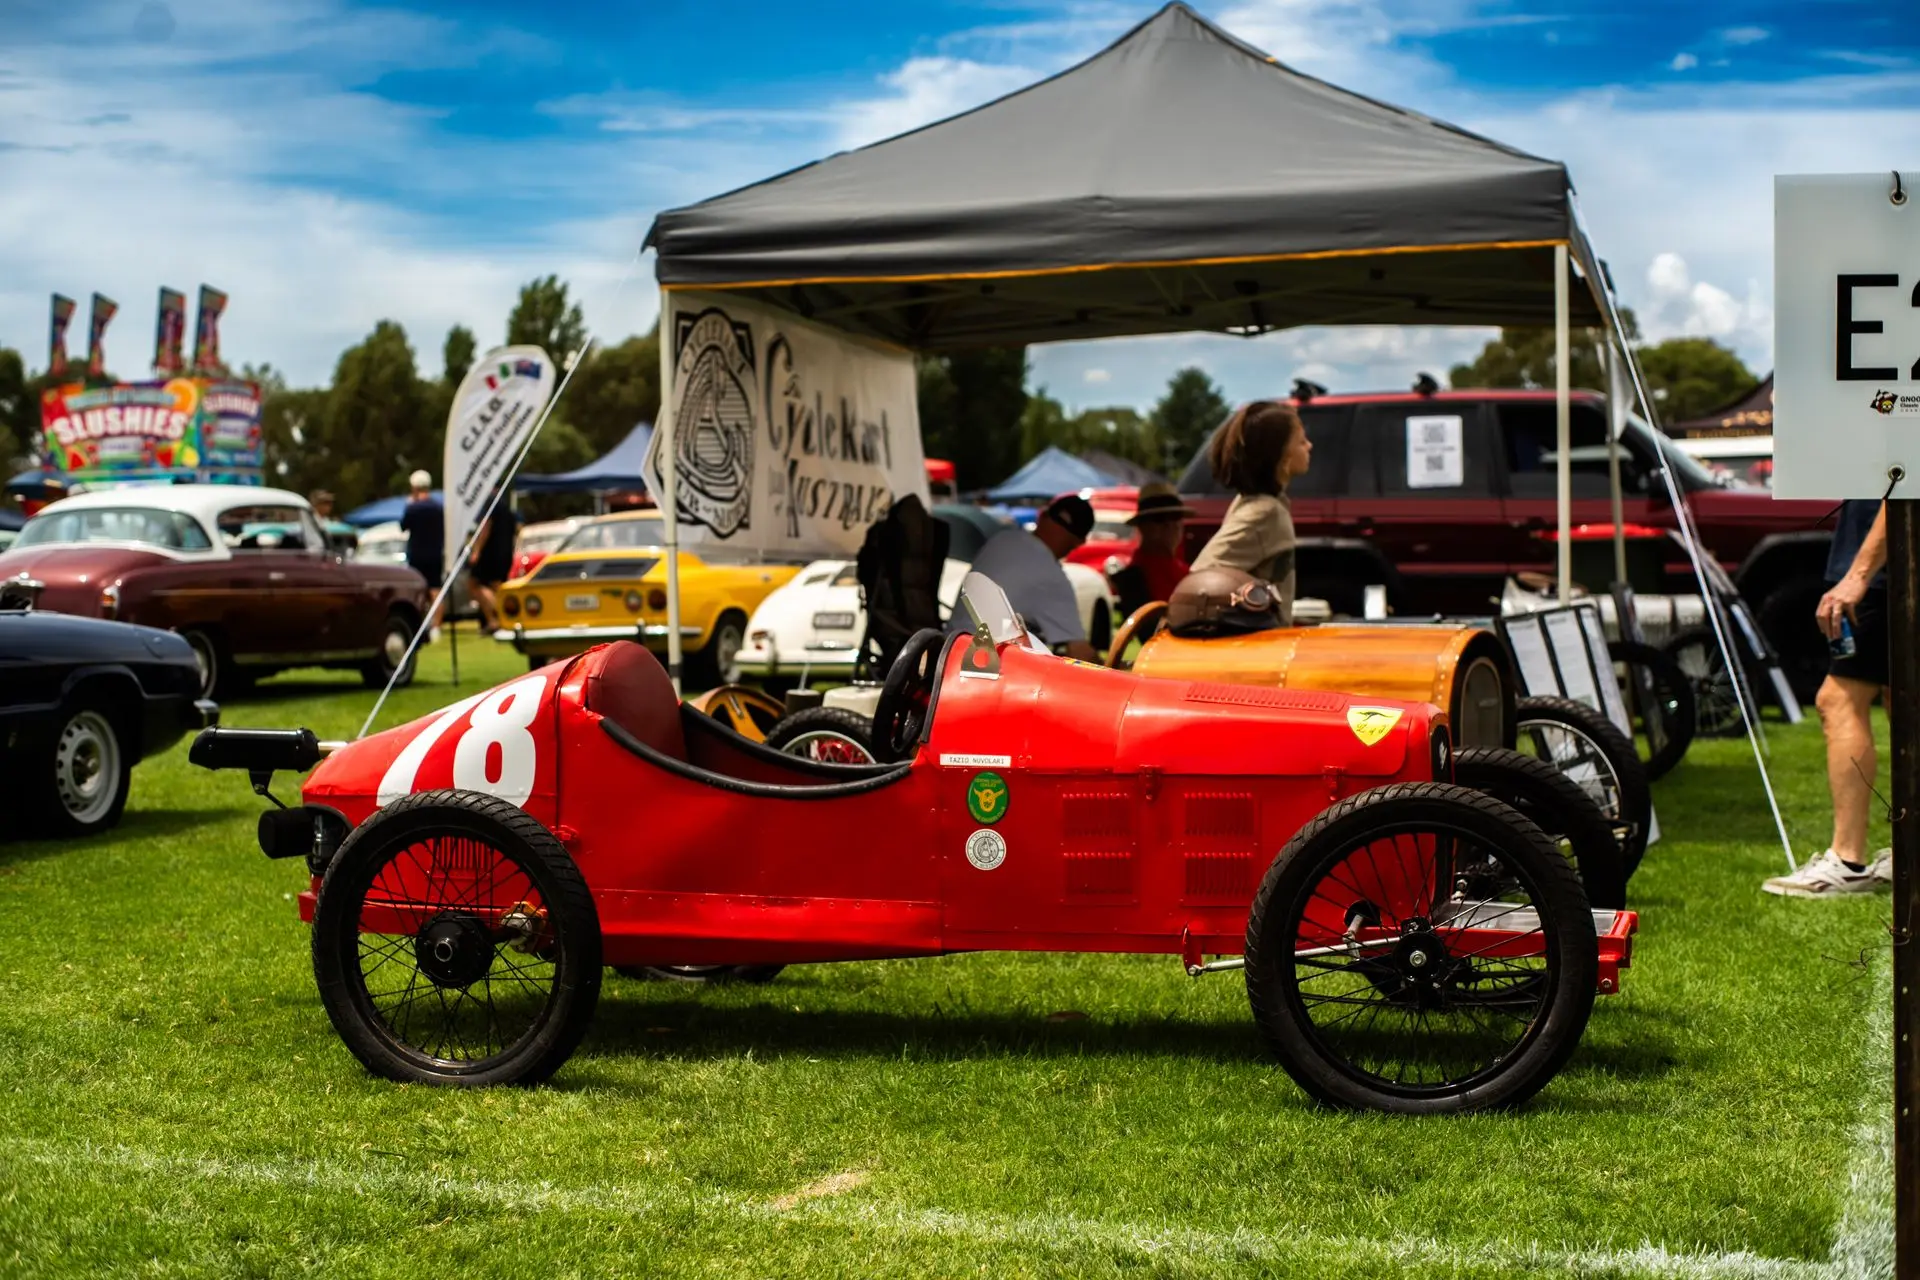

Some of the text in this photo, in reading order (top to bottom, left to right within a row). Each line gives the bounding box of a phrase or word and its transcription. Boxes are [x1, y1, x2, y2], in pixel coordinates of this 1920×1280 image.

[1836, 274, 1920, 380] E
[51, 406, 189, 444] SLUSHIES
[376, 664, 548, 809] 78
[949, 756, 1005, 765] TAZIO NUVOLARI
